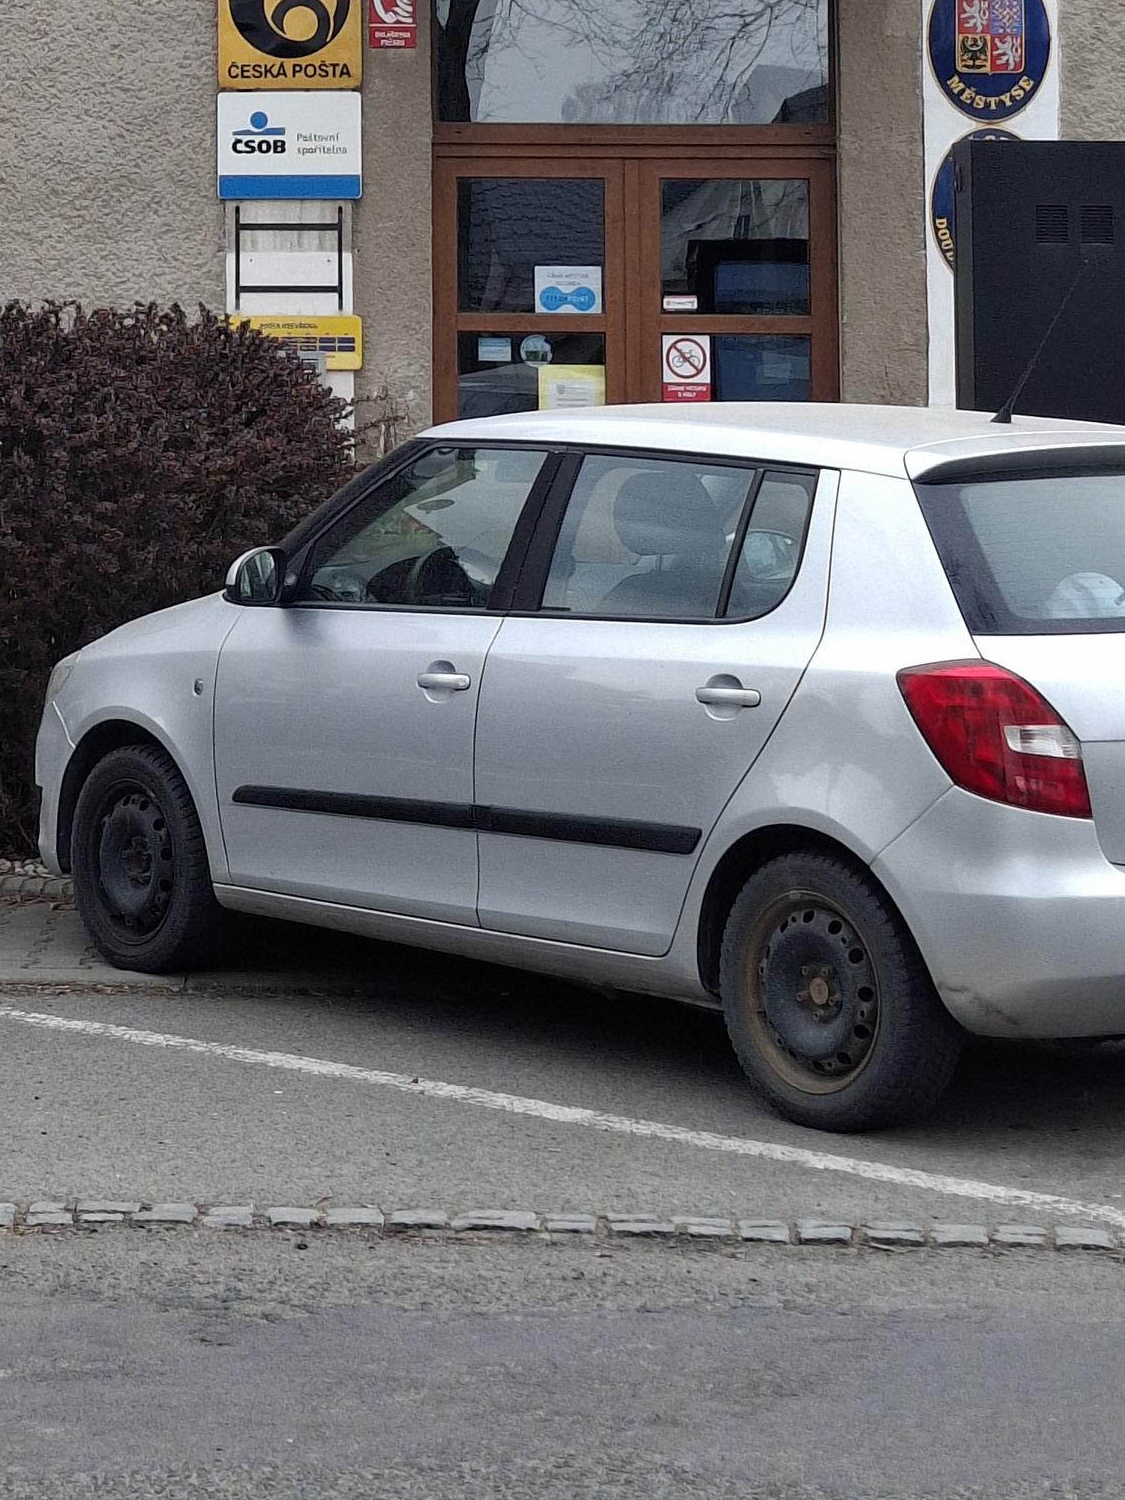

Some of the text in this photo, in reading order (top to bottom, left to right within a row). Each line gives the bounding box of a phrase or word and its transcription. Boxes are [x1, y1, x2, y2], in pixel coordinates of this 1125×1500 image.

[227, 60, 352, 79] ČESKÁ POŠTA
[947, 75, 1034, 110] MĚSTYSE
[231, 137, 287, 154] ČSOB
[297, 144, 348, 156] spořitelna
